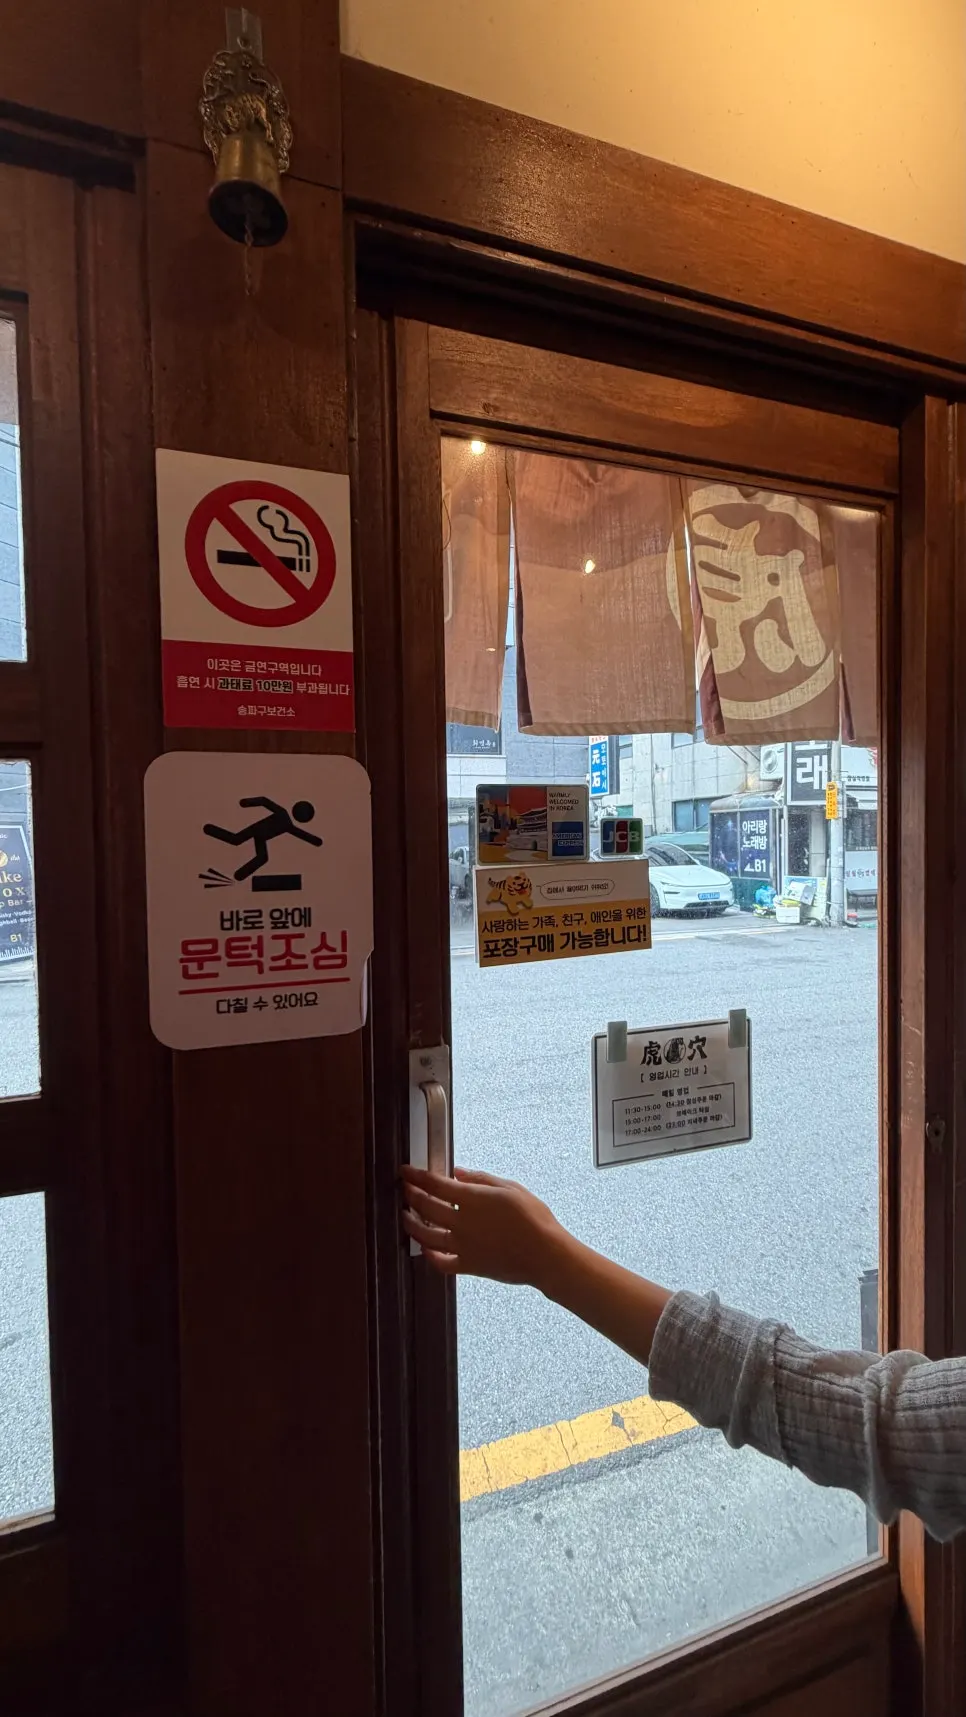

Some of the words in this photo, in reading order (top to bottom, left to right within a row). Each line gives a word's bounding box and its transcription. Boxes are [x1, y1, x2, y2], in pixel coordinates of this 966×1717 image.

[207, 658, 242, 671] 이곳은
[245, 660, 322, 676] 금연구역입니다
[176, 675, 200, 688] 흡연
[204, 677, 216, 689] 시
[217, 677, 254, 691] 과태료
[256, 680, 293, 693] 10만원
[296, 682, 350, 695] 부과됩니다
[237, 704, 296, 717] 송파구보건소
[742, 820, 768, 834] 아리랑
[602, 831, 640, 843] JCB
[742, 836, 768, 850] 노래방
[754, 859, 767, 872] B1
[220, 908, 265, 931] 바로
[269, 906, 312, 930] 앞에
[481, 918, 529, 934] 사랑하는
[532, 915, 559, 930] 가족,
[562, 912, 588, 926] 친구,
[591, 908, 623, 923] 애인을
[626, 906, 647, 921] 위한
[10, 933, 22, 943] B1
[483, 933, 555, 959] 포장구매
[560, 924, 647, 950] 가능합니다!
[179, 930, 348, 980] 문턱조심
[216, 997, 248, 1014] 다칠
[252, 998, 268, 1011] 수
[272, 991, 318, 1011] 있어요
[650, 1069, 680, 1082] 영업시간
[684, 1066, 699, 1078] 안내
[676, 1086, 690, 1096] 영업
